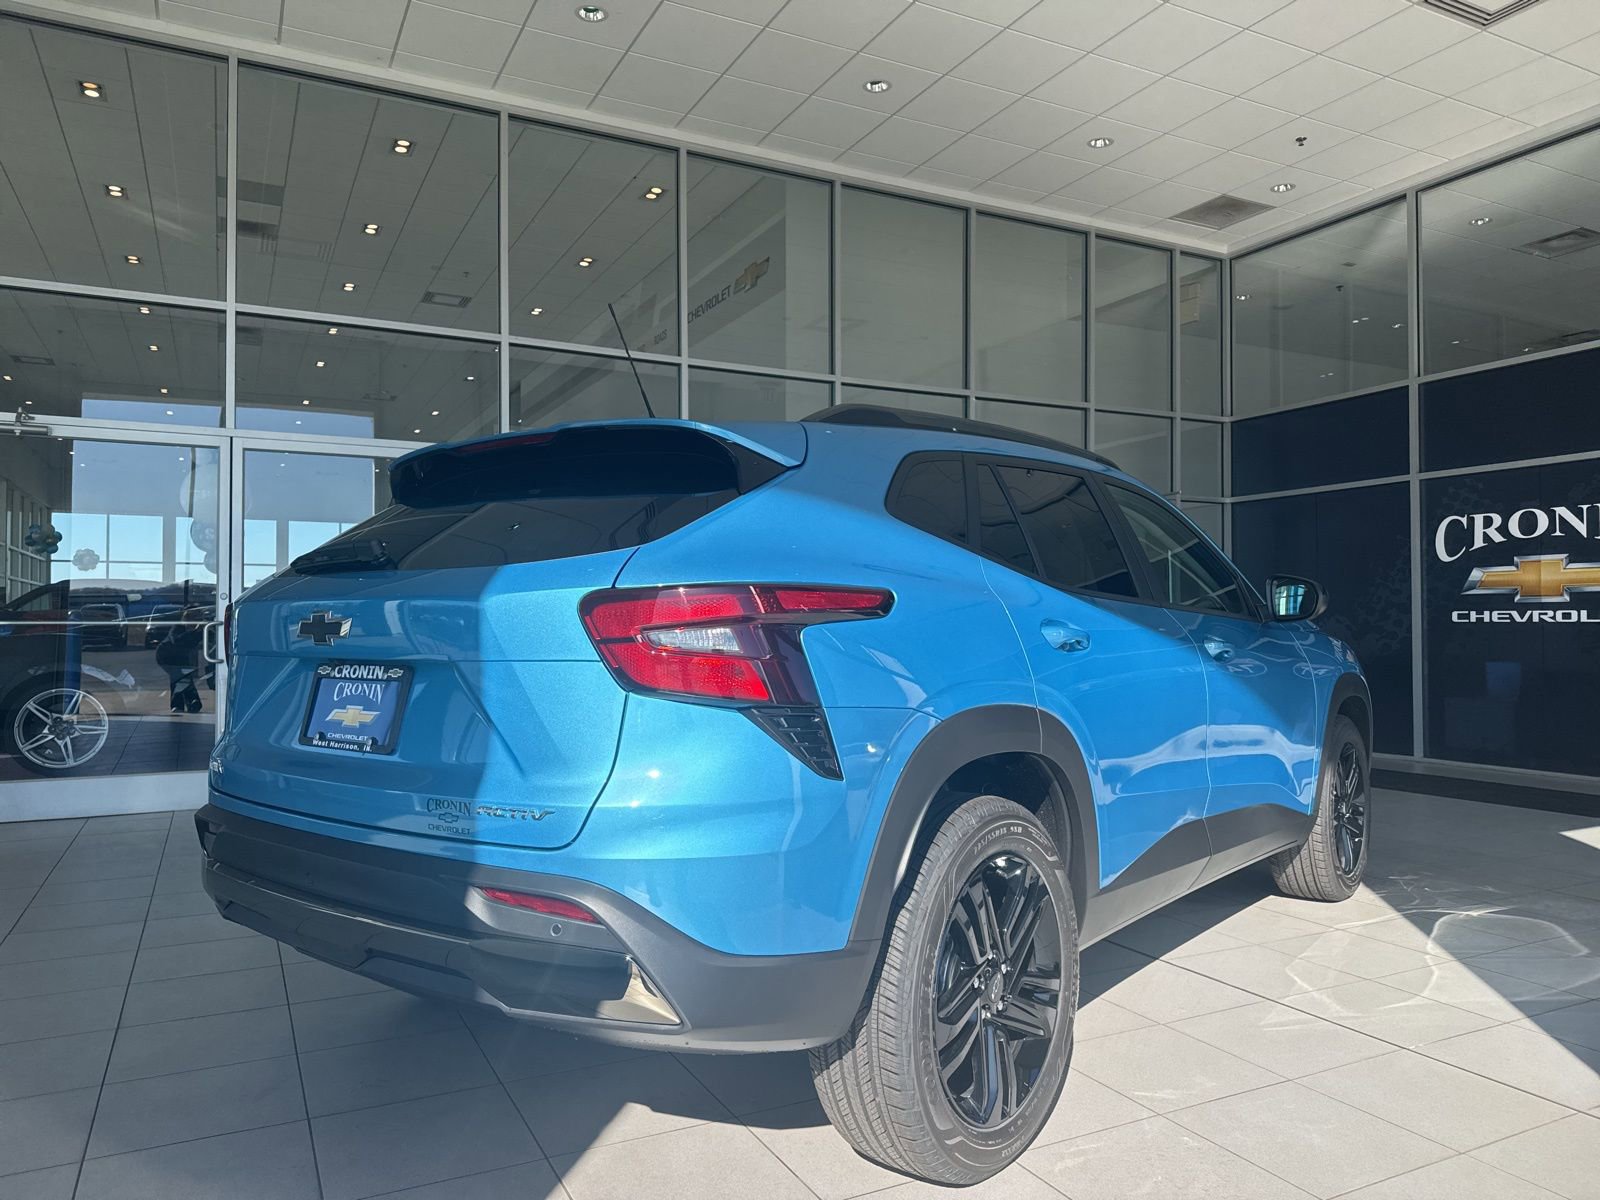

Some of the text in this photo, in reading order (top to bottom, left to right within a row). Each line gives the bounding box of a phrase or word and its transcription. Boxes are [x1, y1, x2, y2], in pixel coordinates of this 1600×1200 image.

[688, 285, 731, 324] CHEVROLET
[1451, 609, 1600, 623] CHEVROL
[334, 664, 385, 680] CRONIN
[333, 681, 385, 705] CRONIN
[312, 738, 328, 748] West
[327, 732, 369, 742] CHEVROLET
[426, 797, 472, 816] CRONIN
[427, 823, 471, 836] CHEVROLET
